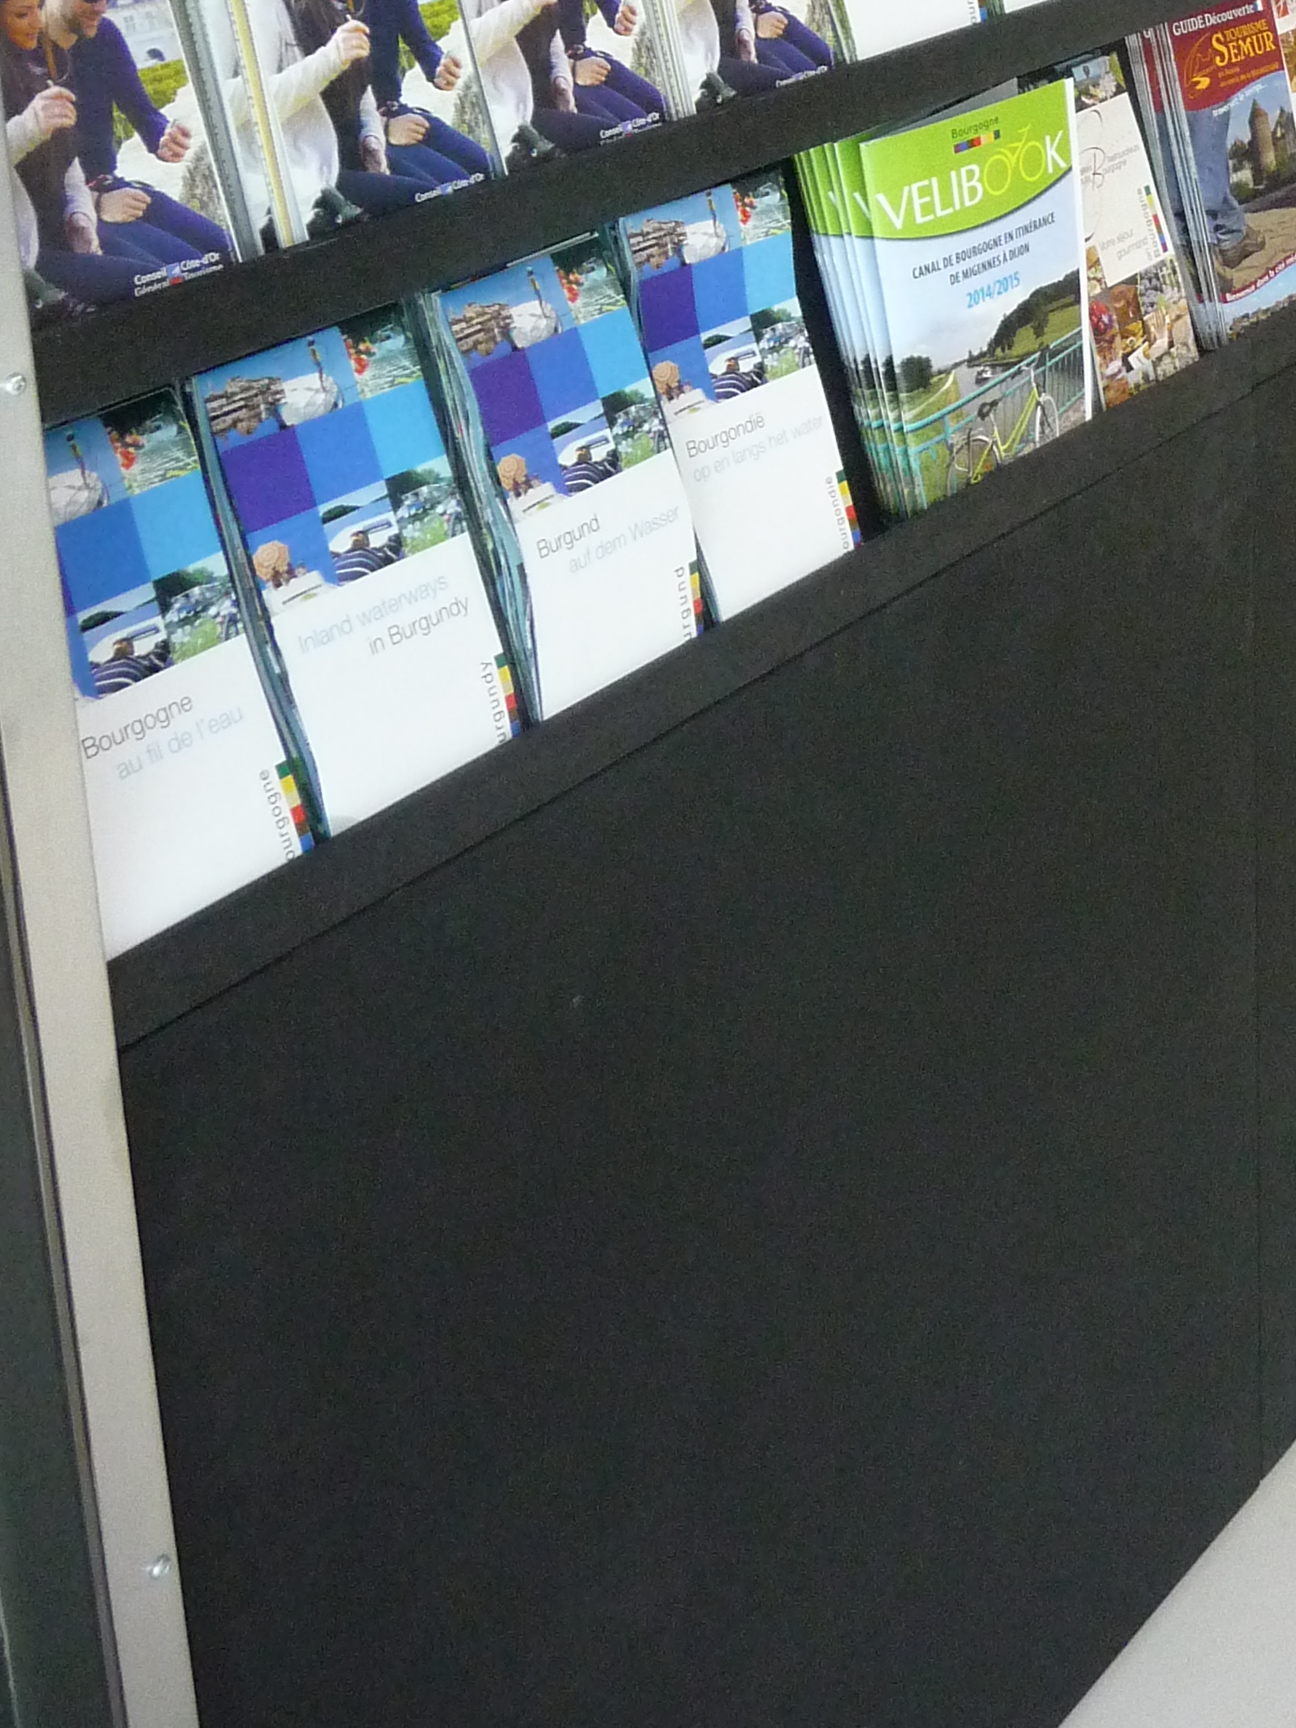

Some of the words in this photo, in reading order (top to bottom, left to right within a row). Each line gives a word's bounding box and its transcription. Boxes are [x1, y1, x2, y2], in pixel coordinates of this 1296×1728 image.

[1172, 14, 1205, 36] GUIDE
[1204, 4, 1254, 27] Découverte
[1224, 18, 1269, 41] TOURISME
[1211, 30, 1277, 67] SEMUR
[951, 116, 1000, 140] Bourgogne
[912, 258, 942, 281] CANAL
[943, 254, 955, 269] DE
[954, 236, 1004, 267] BOURGOGNE
[1004, 230, 1015, 246] EN
[1014, 212, 1057, 242] ITINÉRANCE
[949, 272, 961, 286] DE
[960, 255, 1002, 284] MIGENNES
[1009, 243, 1031, 265] DIJON
[134, 266, 168, 286] Conseil
[966, 271, 1021, 309] 2014/2015
[685, 411, 766, 459] Bourgondië
[693, 464, 713, 484] op
[714, 457, 731, 474] en
[732, 441, 767, 468] langs
[768, 428, 790, 450] het
[790, 414, 824, 440] water
[536, 513, 601, 559] Burgund
[568, 555, 593, 575] auf
[595, 533, 629, 564] dem
[629, 505, 680, 541] Wasser
[298, 613, 352, 654] Inland
[356, 575, 450, 627] waterways
[368, 635, 385, 656] in
[387, 595, 469, 647] Burgundy
[82, 694, 194, 760] Bourgogne
[480, 660, 508, 745] urgundy
[116, 756, 143, 780] au
[146, 739, 164, 763] fil
[167, 729, 193, 755] de
[198, 705, 244, 735] l'eau
[260, 768, 296, 862] ourgogne
